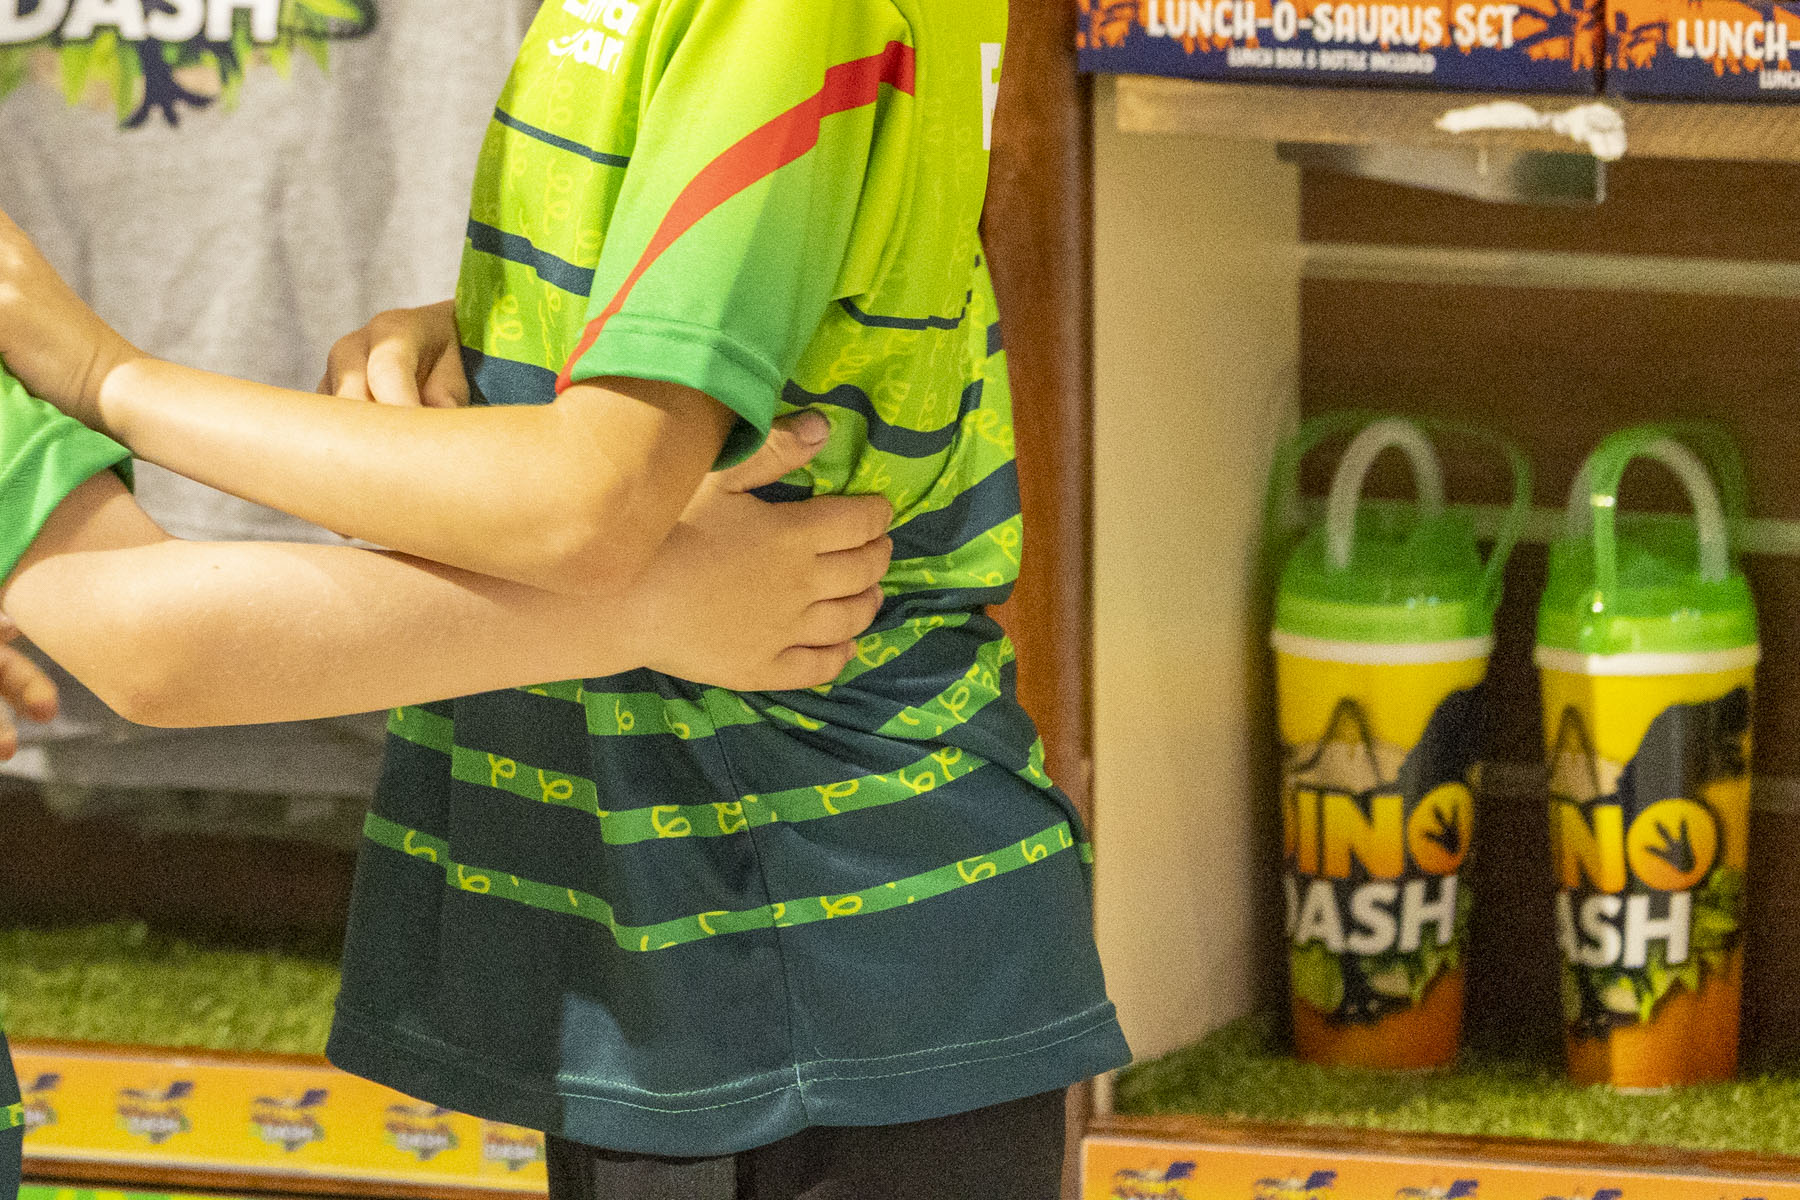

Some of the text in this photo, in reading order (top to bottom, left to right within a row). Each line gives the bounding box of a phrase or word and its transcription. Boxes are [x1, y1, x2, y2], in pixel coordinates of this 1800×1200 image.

[1453, 2, 1520, 49] SET
[1283, 781, 1474, 880] INO
[1285, 874, 1459, 955] ASH
